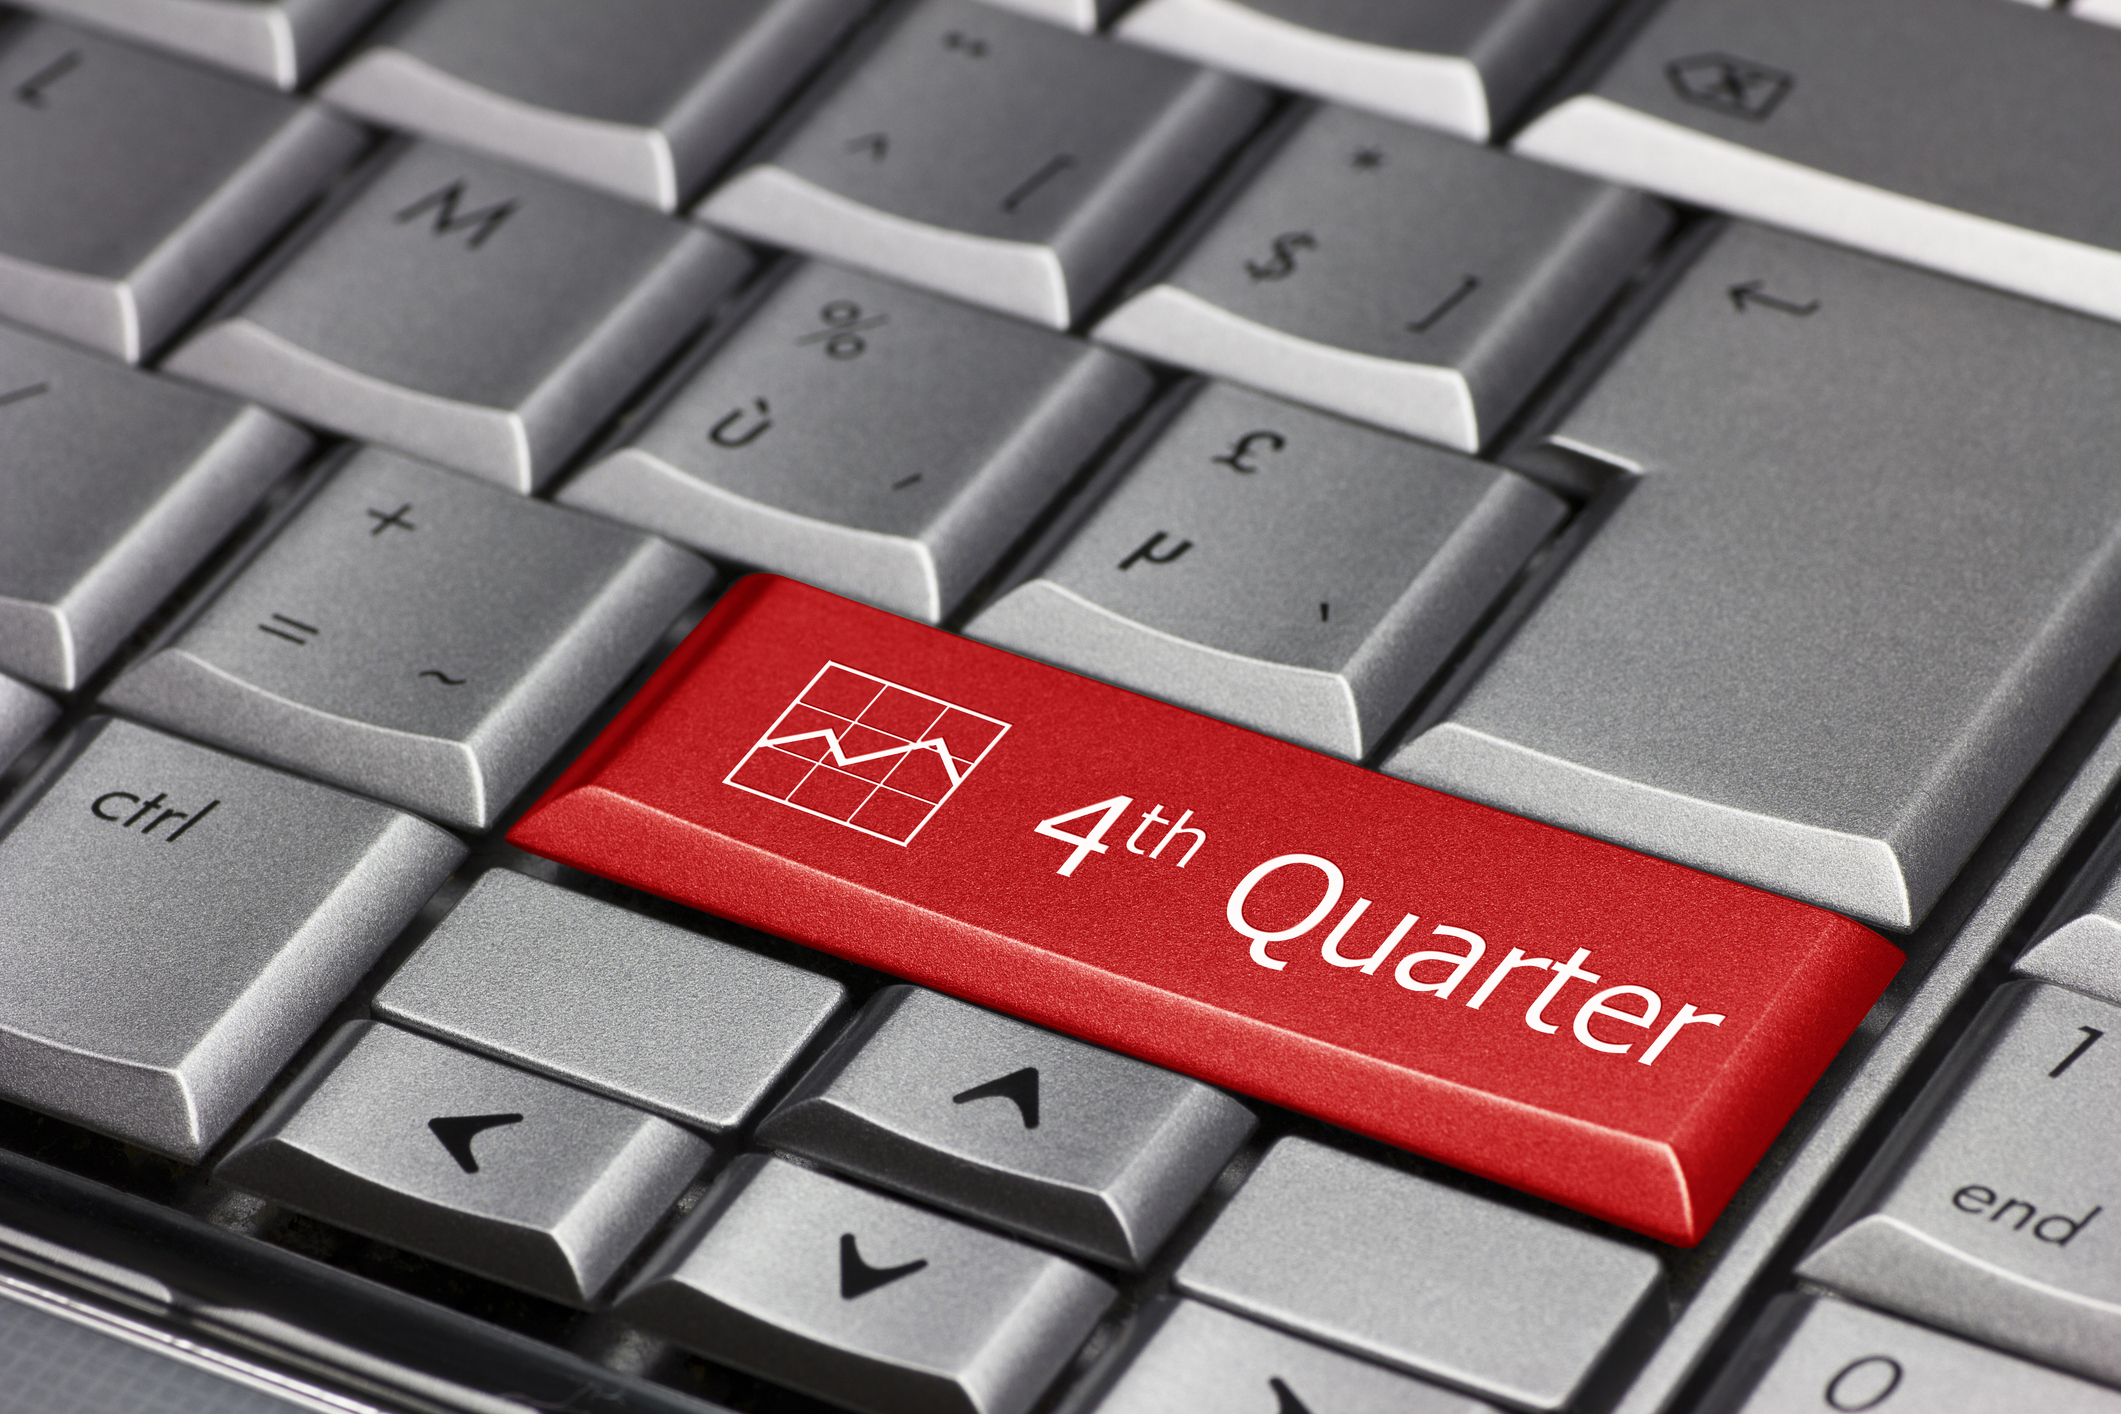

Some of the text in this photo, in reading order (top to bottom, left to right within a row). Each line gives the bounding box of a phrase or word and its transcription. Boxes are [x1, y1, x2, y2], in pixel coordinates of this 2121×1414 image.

[394, 177, 516, 249] M
[1244, 231, 1317, 282] $
[796, 300, 888, 361] %
[708, 398, 771, 448] ù
[1211, 430, 1286, 475] £
[368, 505, 413, 535] +
[258, 613, 319, 645] =
[91, 791, 220, 842] ctrl
[1034, 796, 1725, 1065] 4th Quarter
[2049, 1026, 2103, 1078] 1
[1952, 1185, 2102, 1247] end
